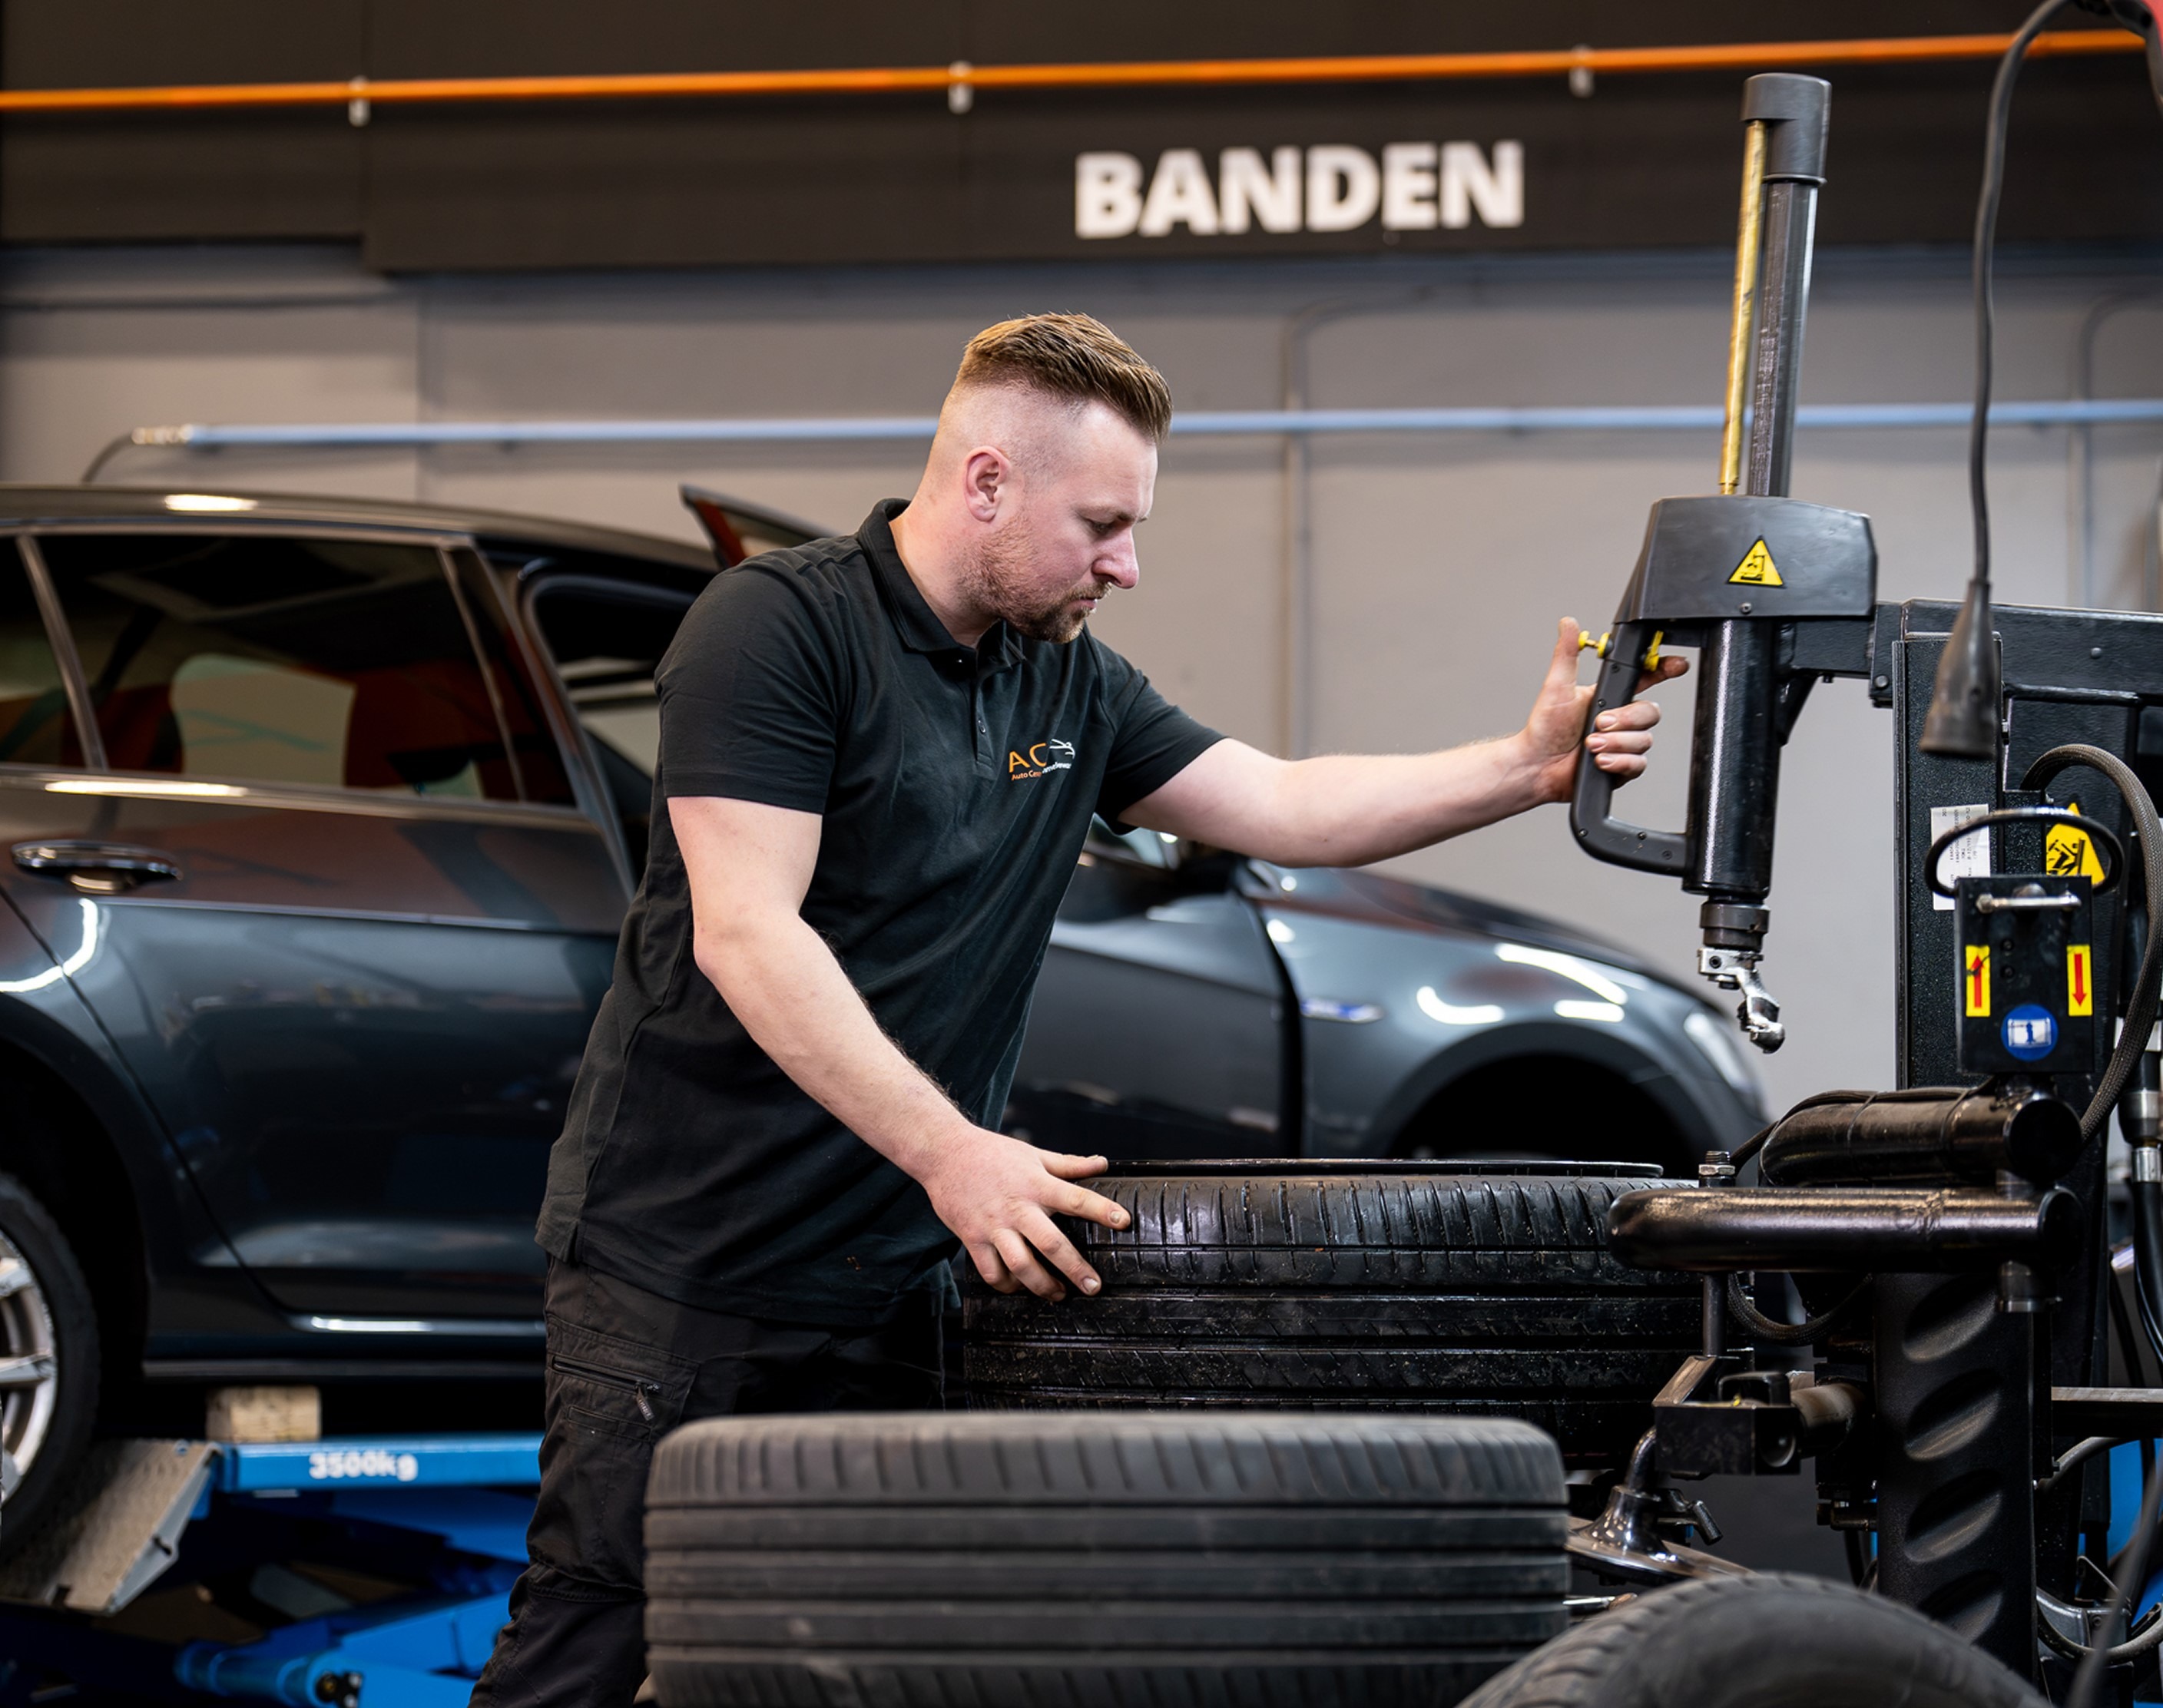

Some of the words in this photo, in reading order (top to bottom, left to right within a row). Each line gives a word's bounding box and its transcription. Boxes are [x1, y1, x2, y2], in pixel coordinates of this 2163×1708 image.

[1075, 141, 1525, 239] BANDEN
[1011, 771, 1029, 781] Auto
[309, 1451, 419, 1482] 3500kg
